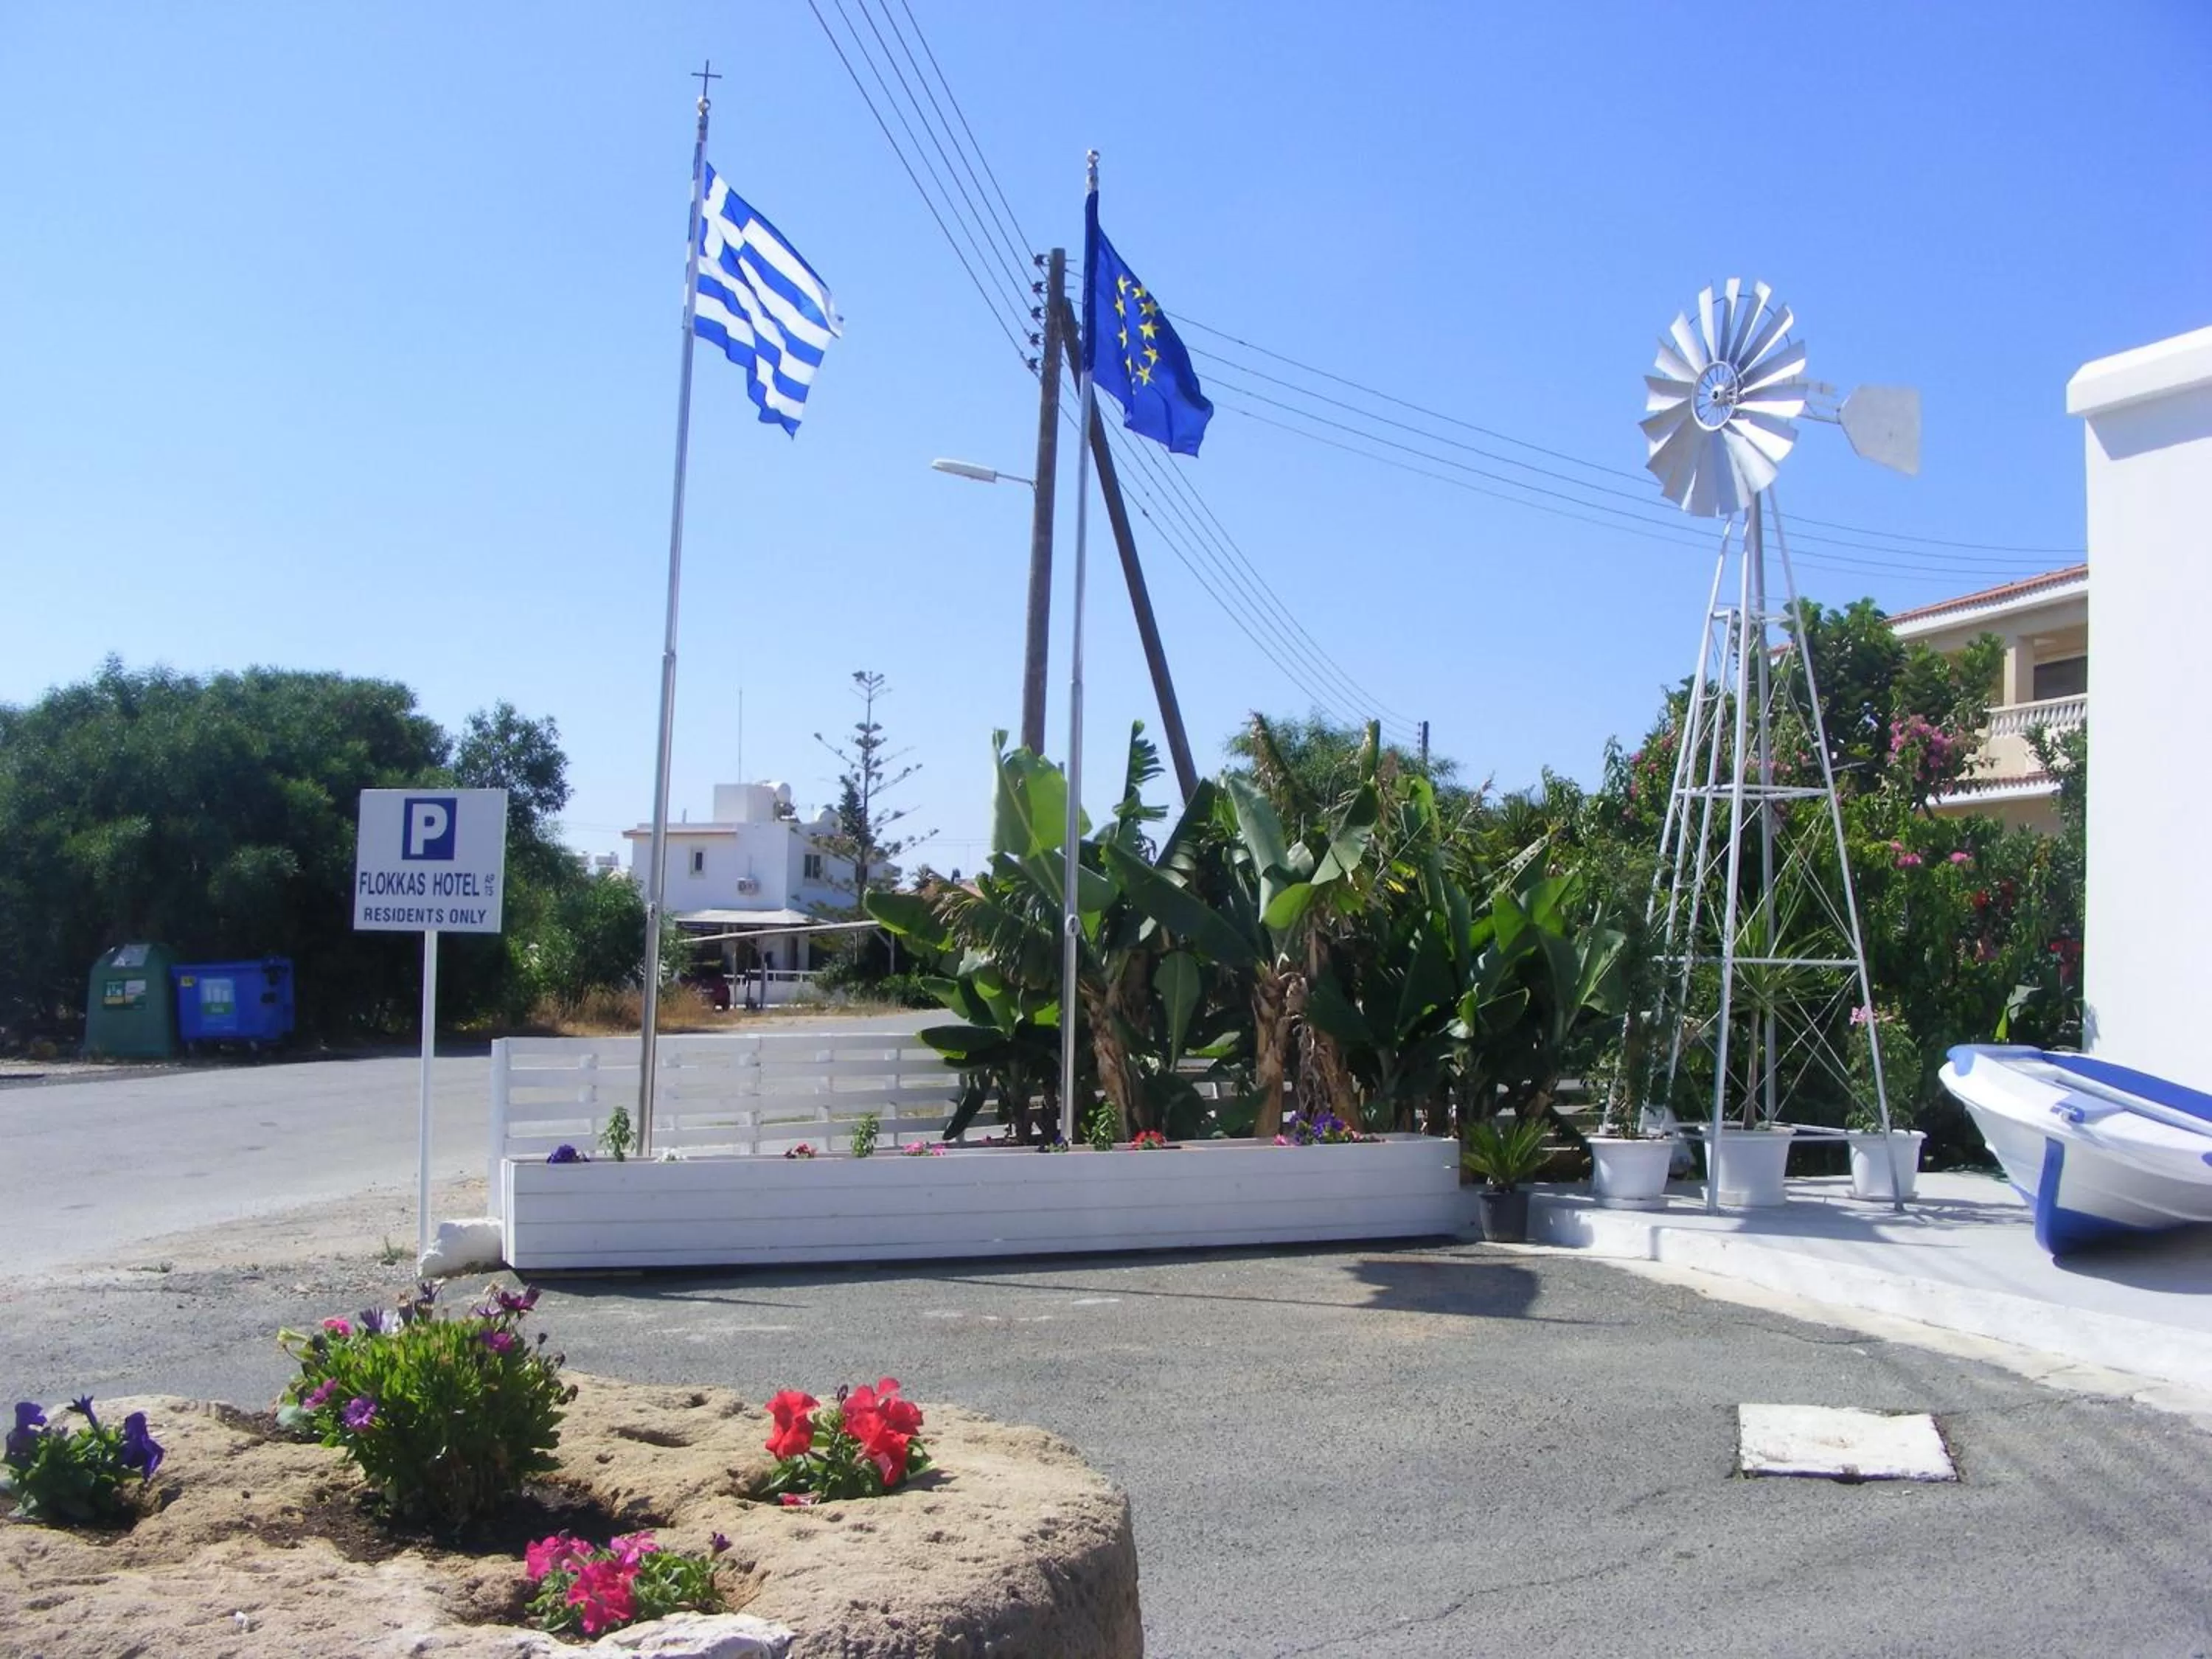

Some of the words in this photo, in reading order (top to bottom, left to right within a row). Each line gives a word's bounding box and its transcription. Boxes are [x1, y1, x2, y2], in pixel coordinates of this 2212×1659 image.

[410, 803, 448, 855] P
[359, 872, 425, 895] FLOKKAS
[433, 872, 479, 897] HOTEL
[364, 907, 444, 922] RESIDENTS
[449, 908, 487, 924] ONLY
